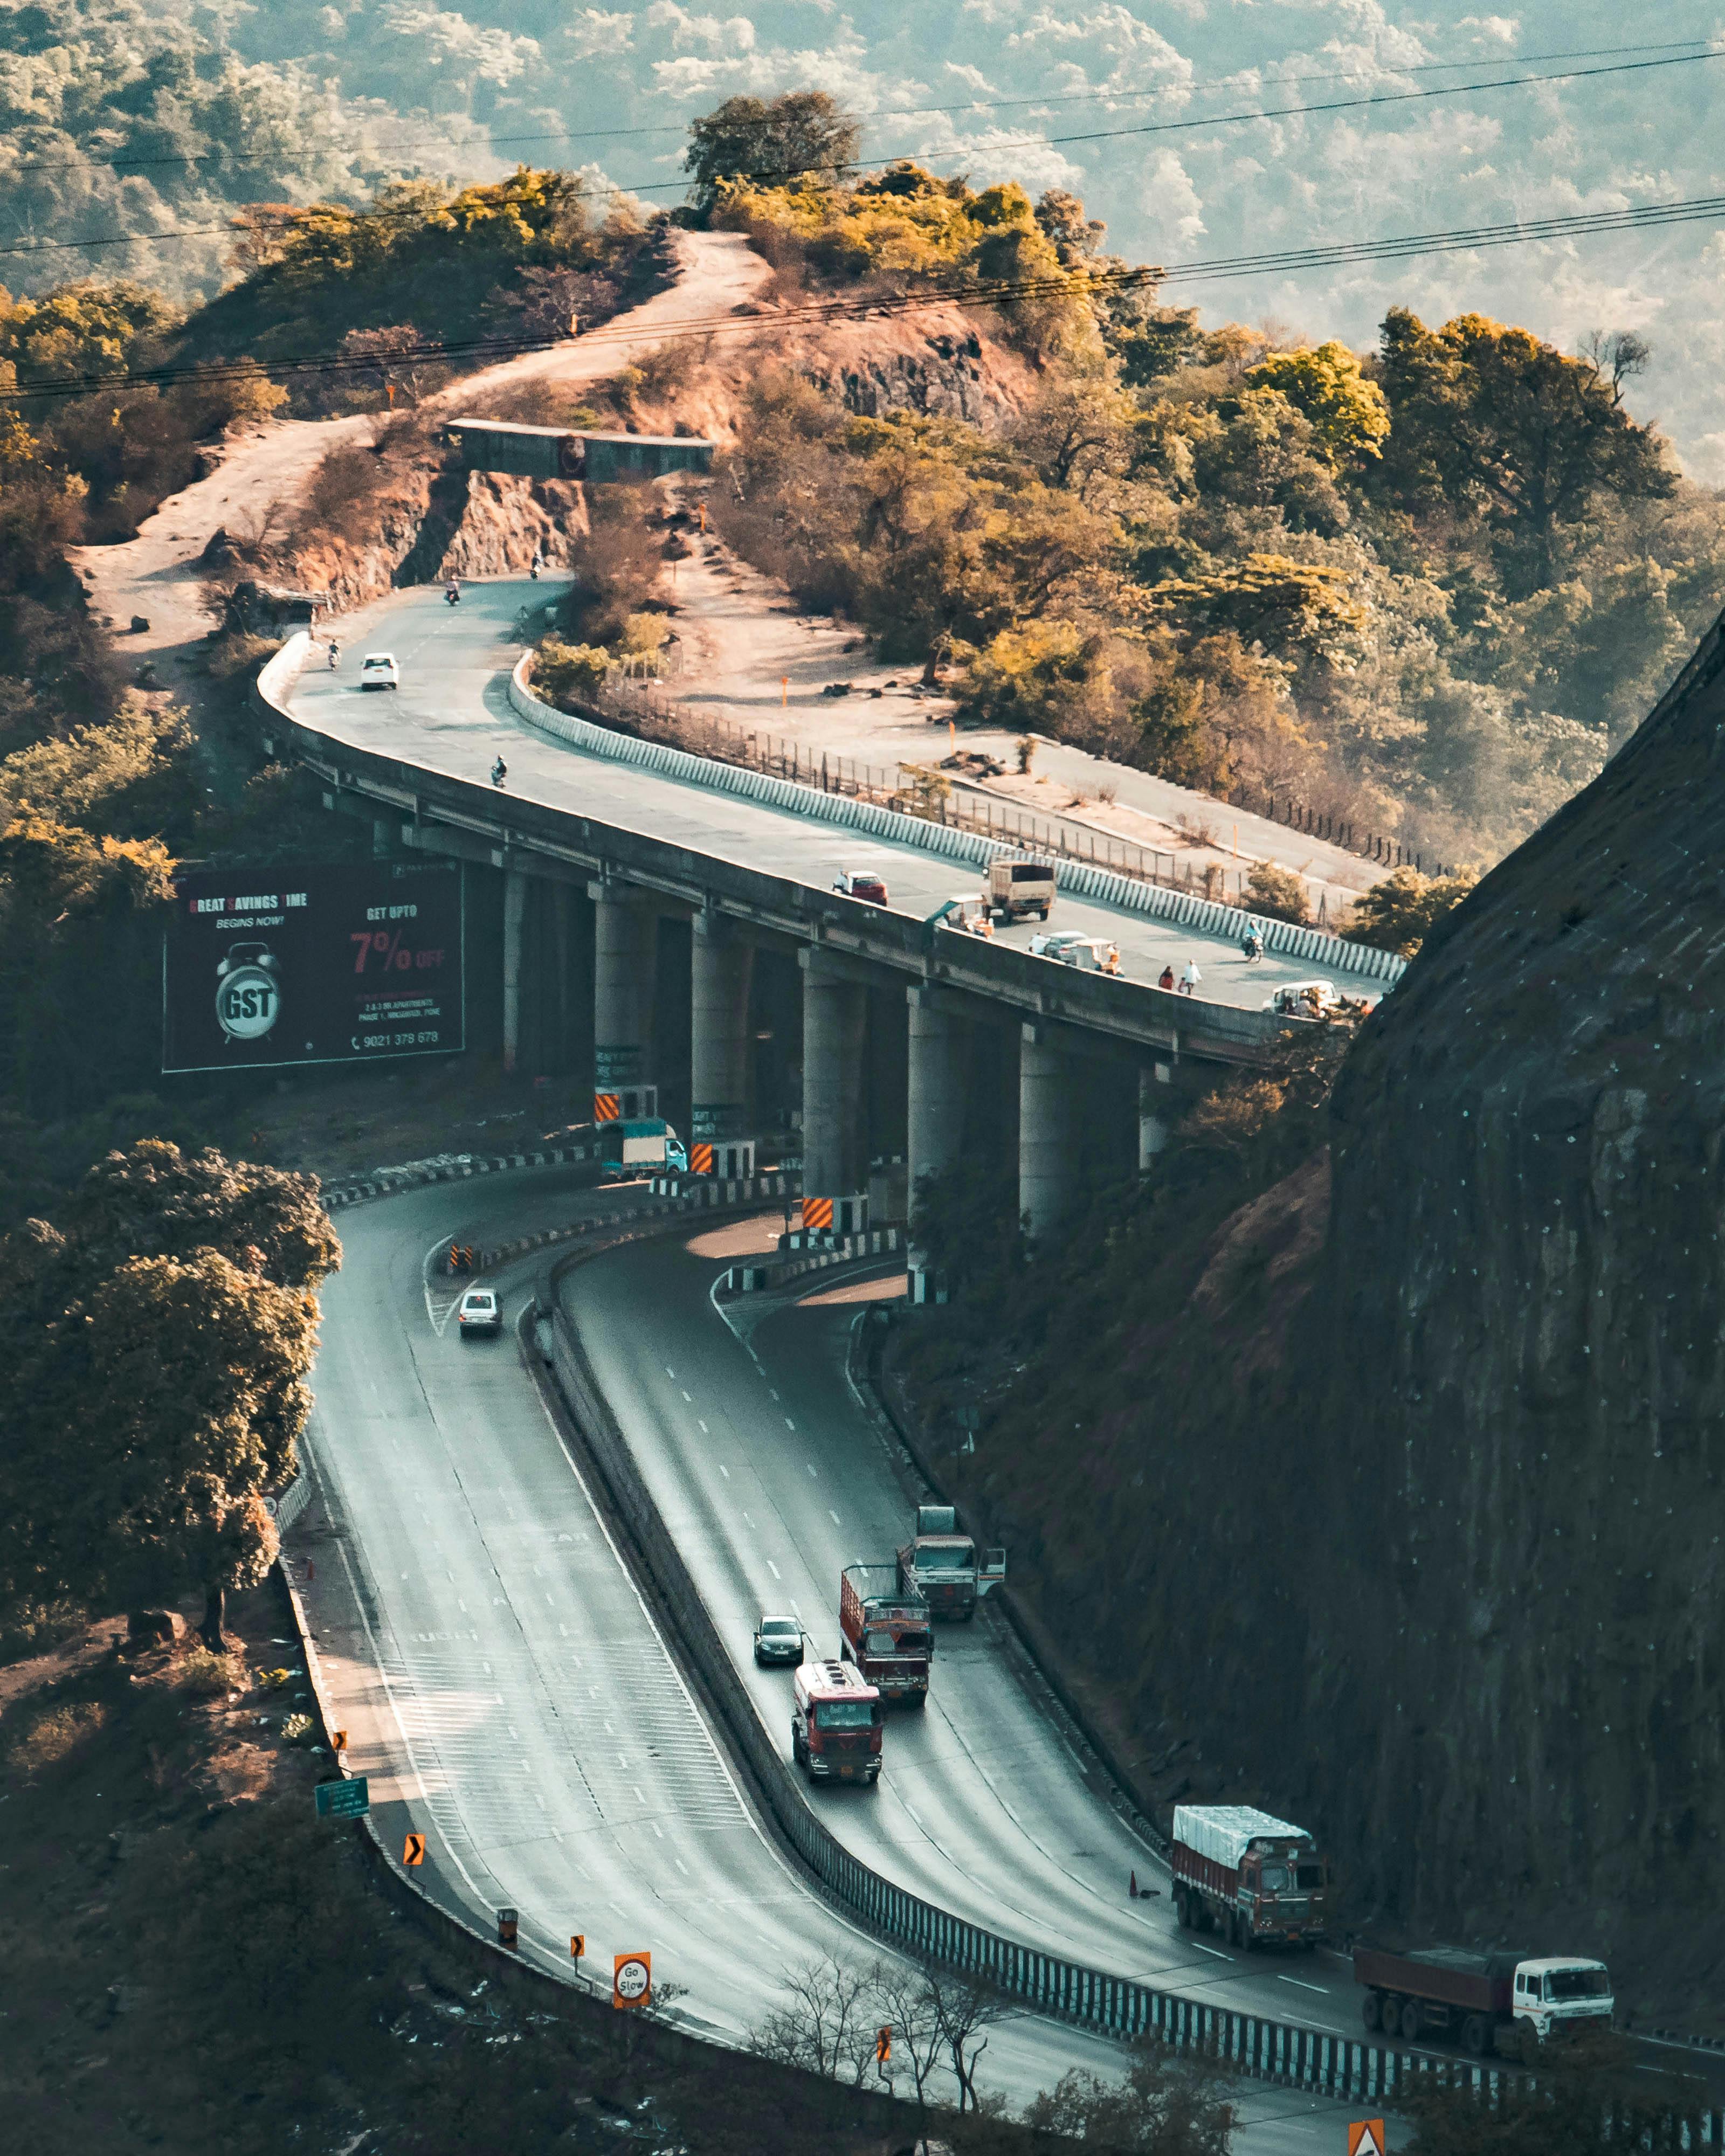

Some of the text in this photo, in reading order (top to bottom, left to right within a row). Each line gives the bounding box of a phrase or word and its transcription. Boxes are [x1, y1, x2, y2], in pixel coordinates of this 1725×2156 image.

[189, 893, 308, 914] GREAT SAVINGS TIME
[367, 904, 417, 921] GET UPTO
[216, 918, 253, 929] BEGINS
[350, 928, 445, 973] 7% OFF
[224, 987, 274, 1020] GST
[363, 1035, 390, 1047] 9021
[625, 1967, 638, 1978] Go
[620, 1981, 644, 1991] Slow
